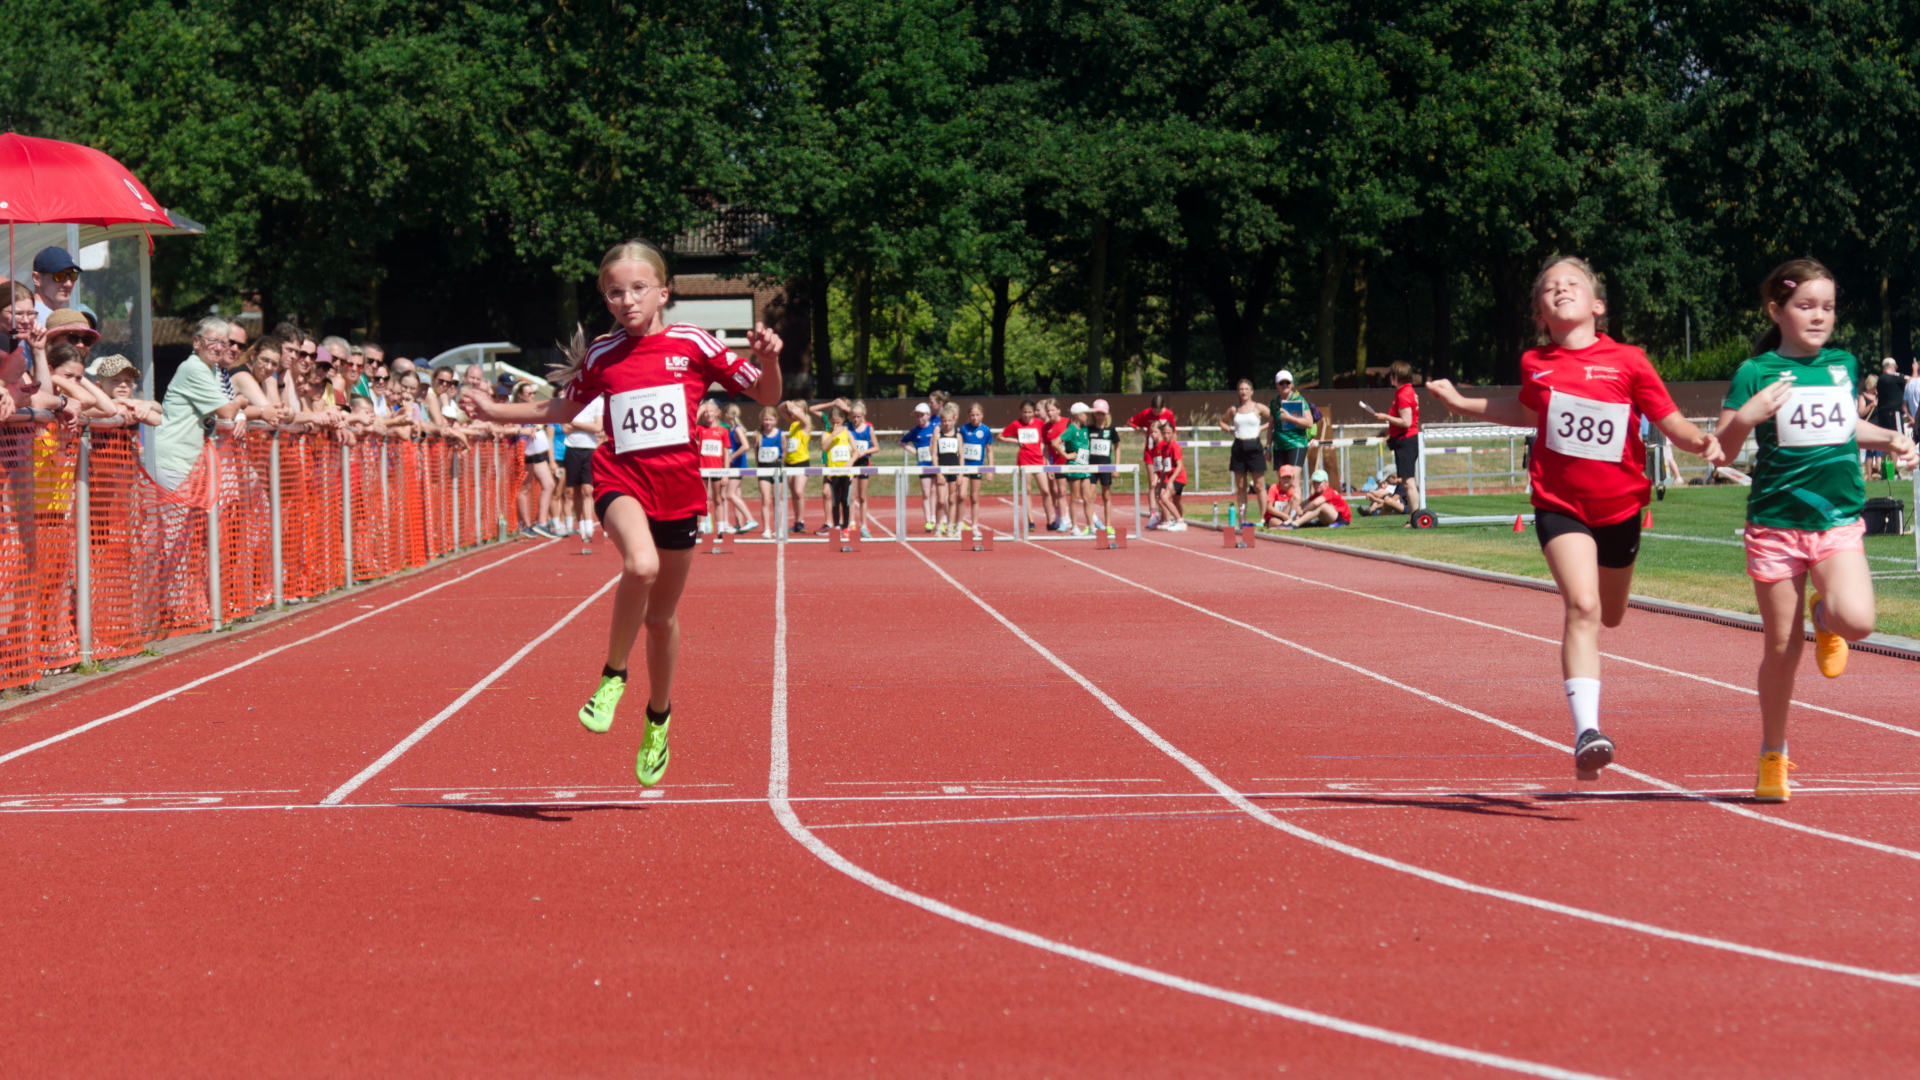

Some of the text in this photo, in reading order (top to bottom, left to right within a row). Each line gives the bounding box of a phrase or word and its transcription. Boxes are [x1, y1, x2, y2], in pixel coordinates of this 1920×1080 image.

[622, 402, 677, 433] 488
[1557, 411, 1615, 445] 389
[1790, 402, 1846, 430] 454
